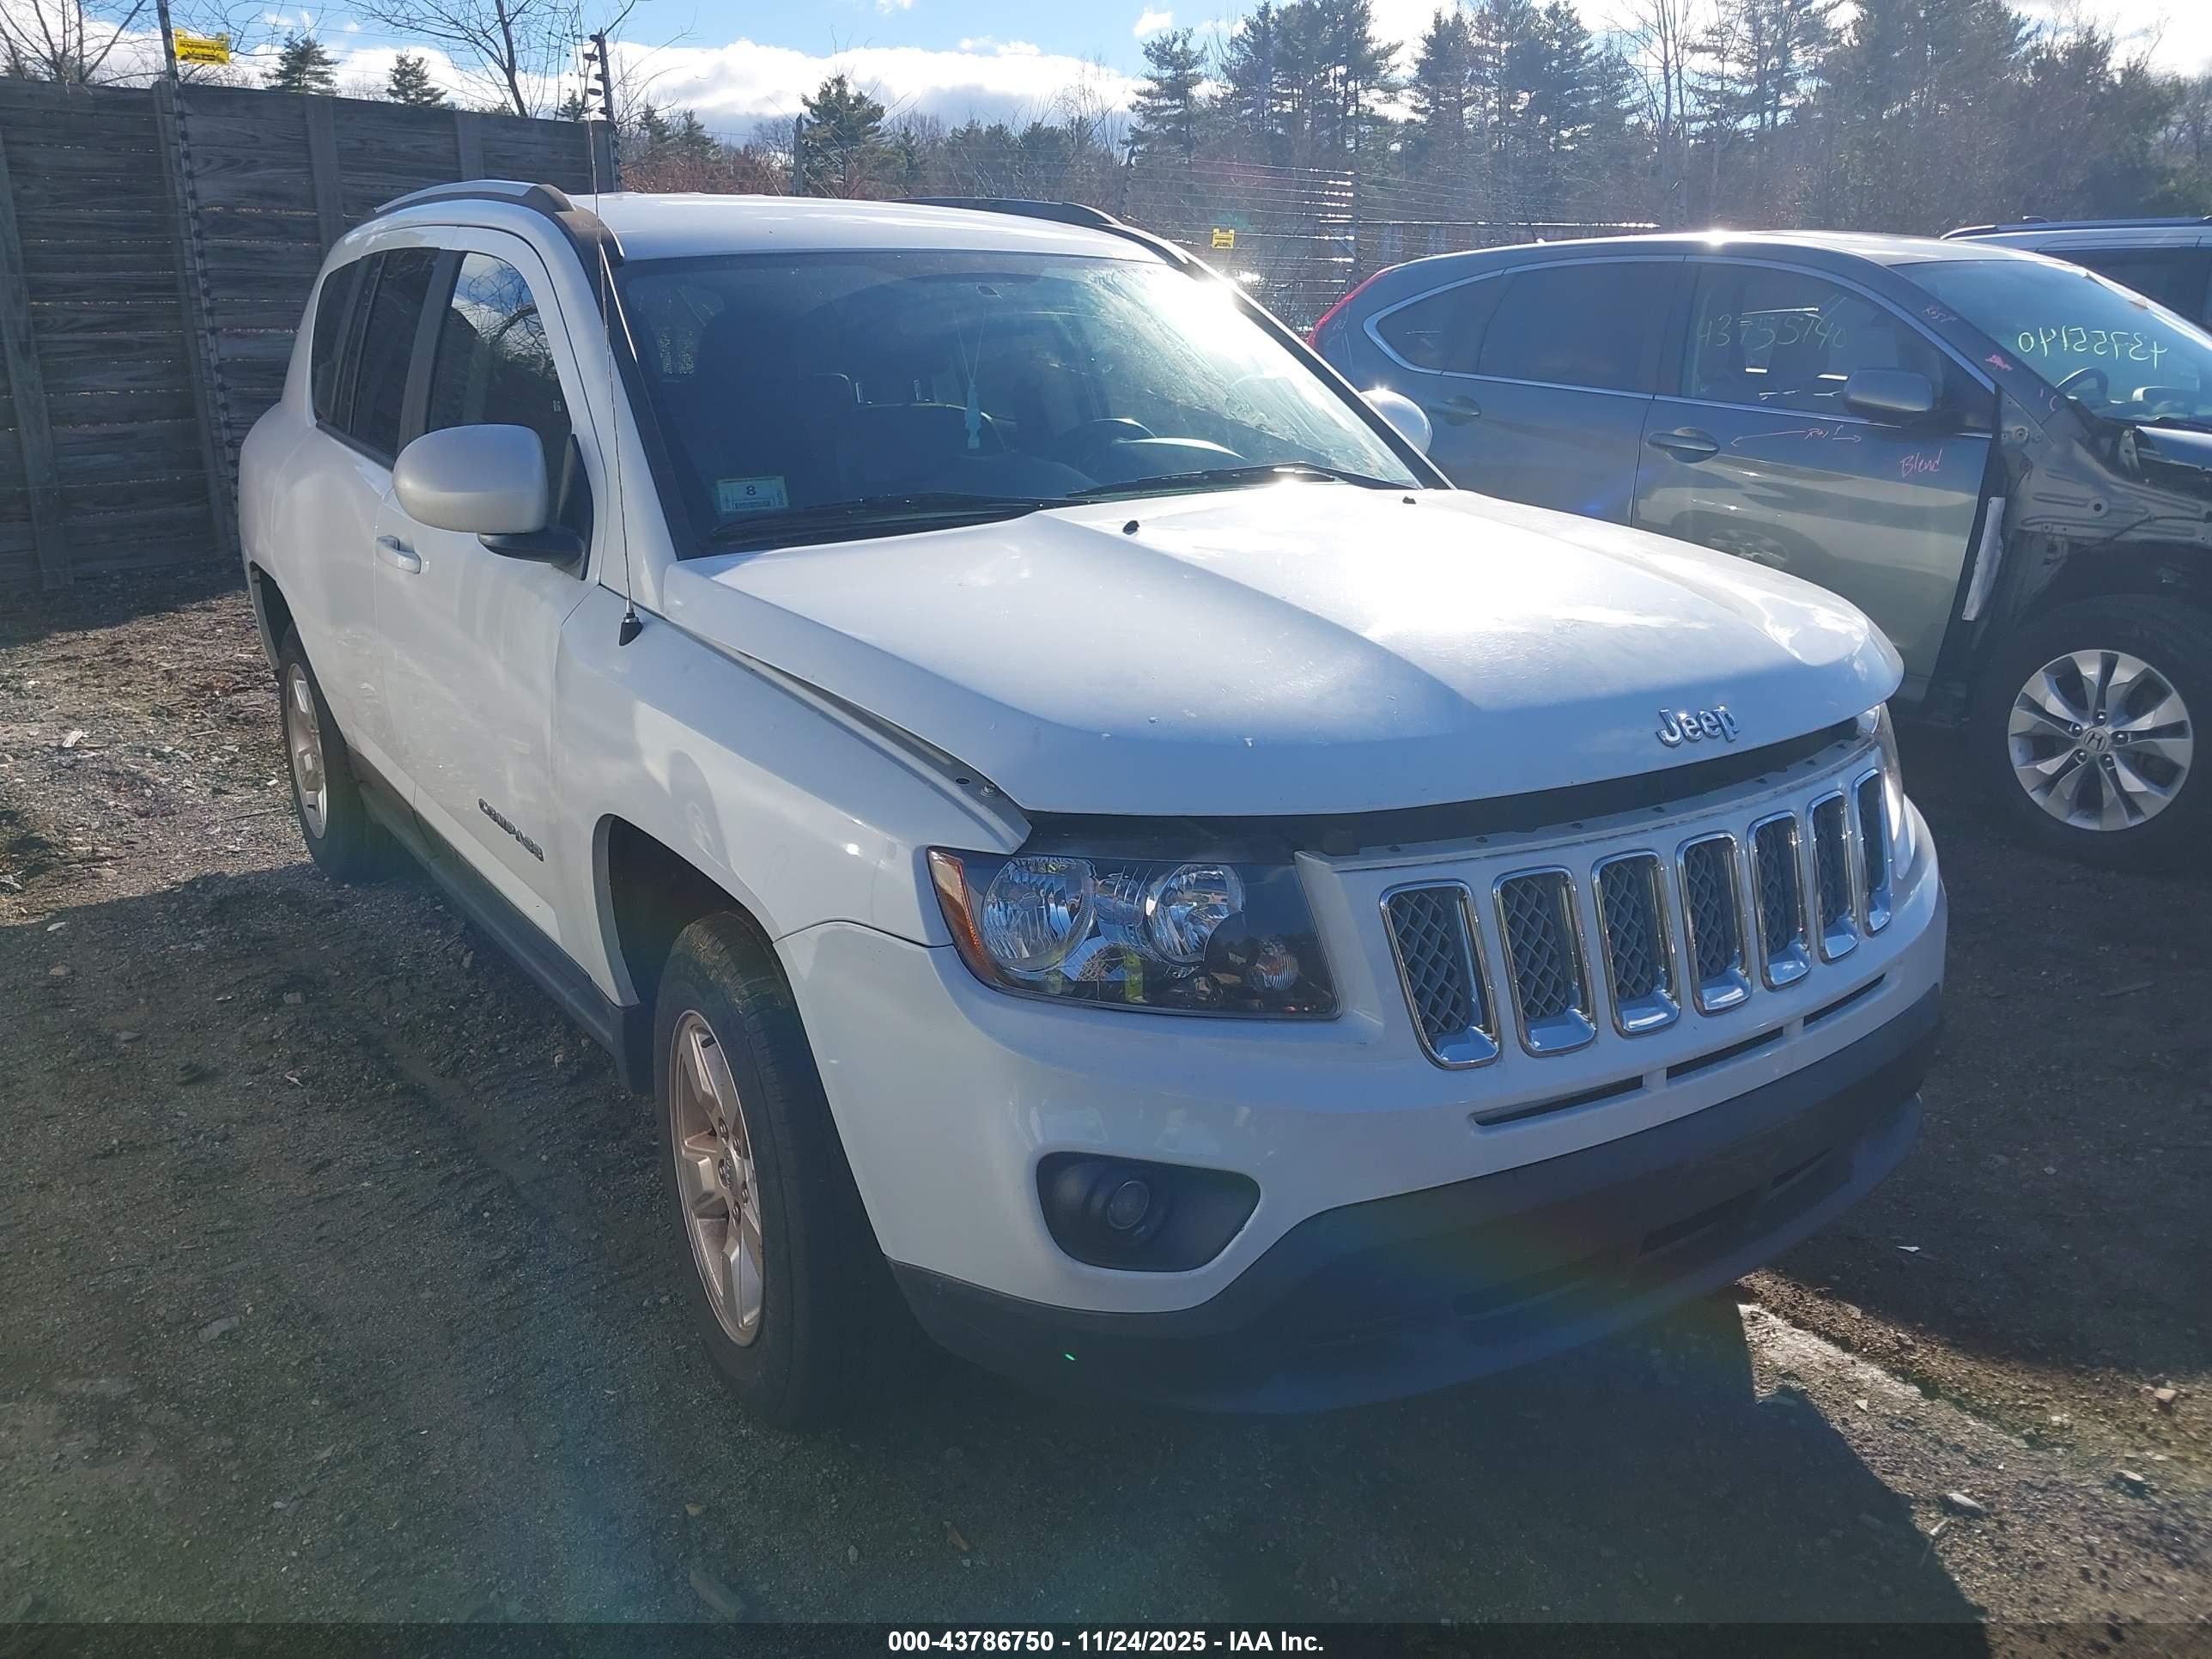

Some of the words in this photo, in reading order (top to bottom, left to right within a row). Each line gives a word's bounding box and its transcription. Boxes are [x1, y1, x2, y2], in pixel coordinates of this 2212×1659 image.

[1899, 448, 1943, 478] Blend
[745, 485, 757, 496] 8
[1655, 705, 1740, 748] Jeep
